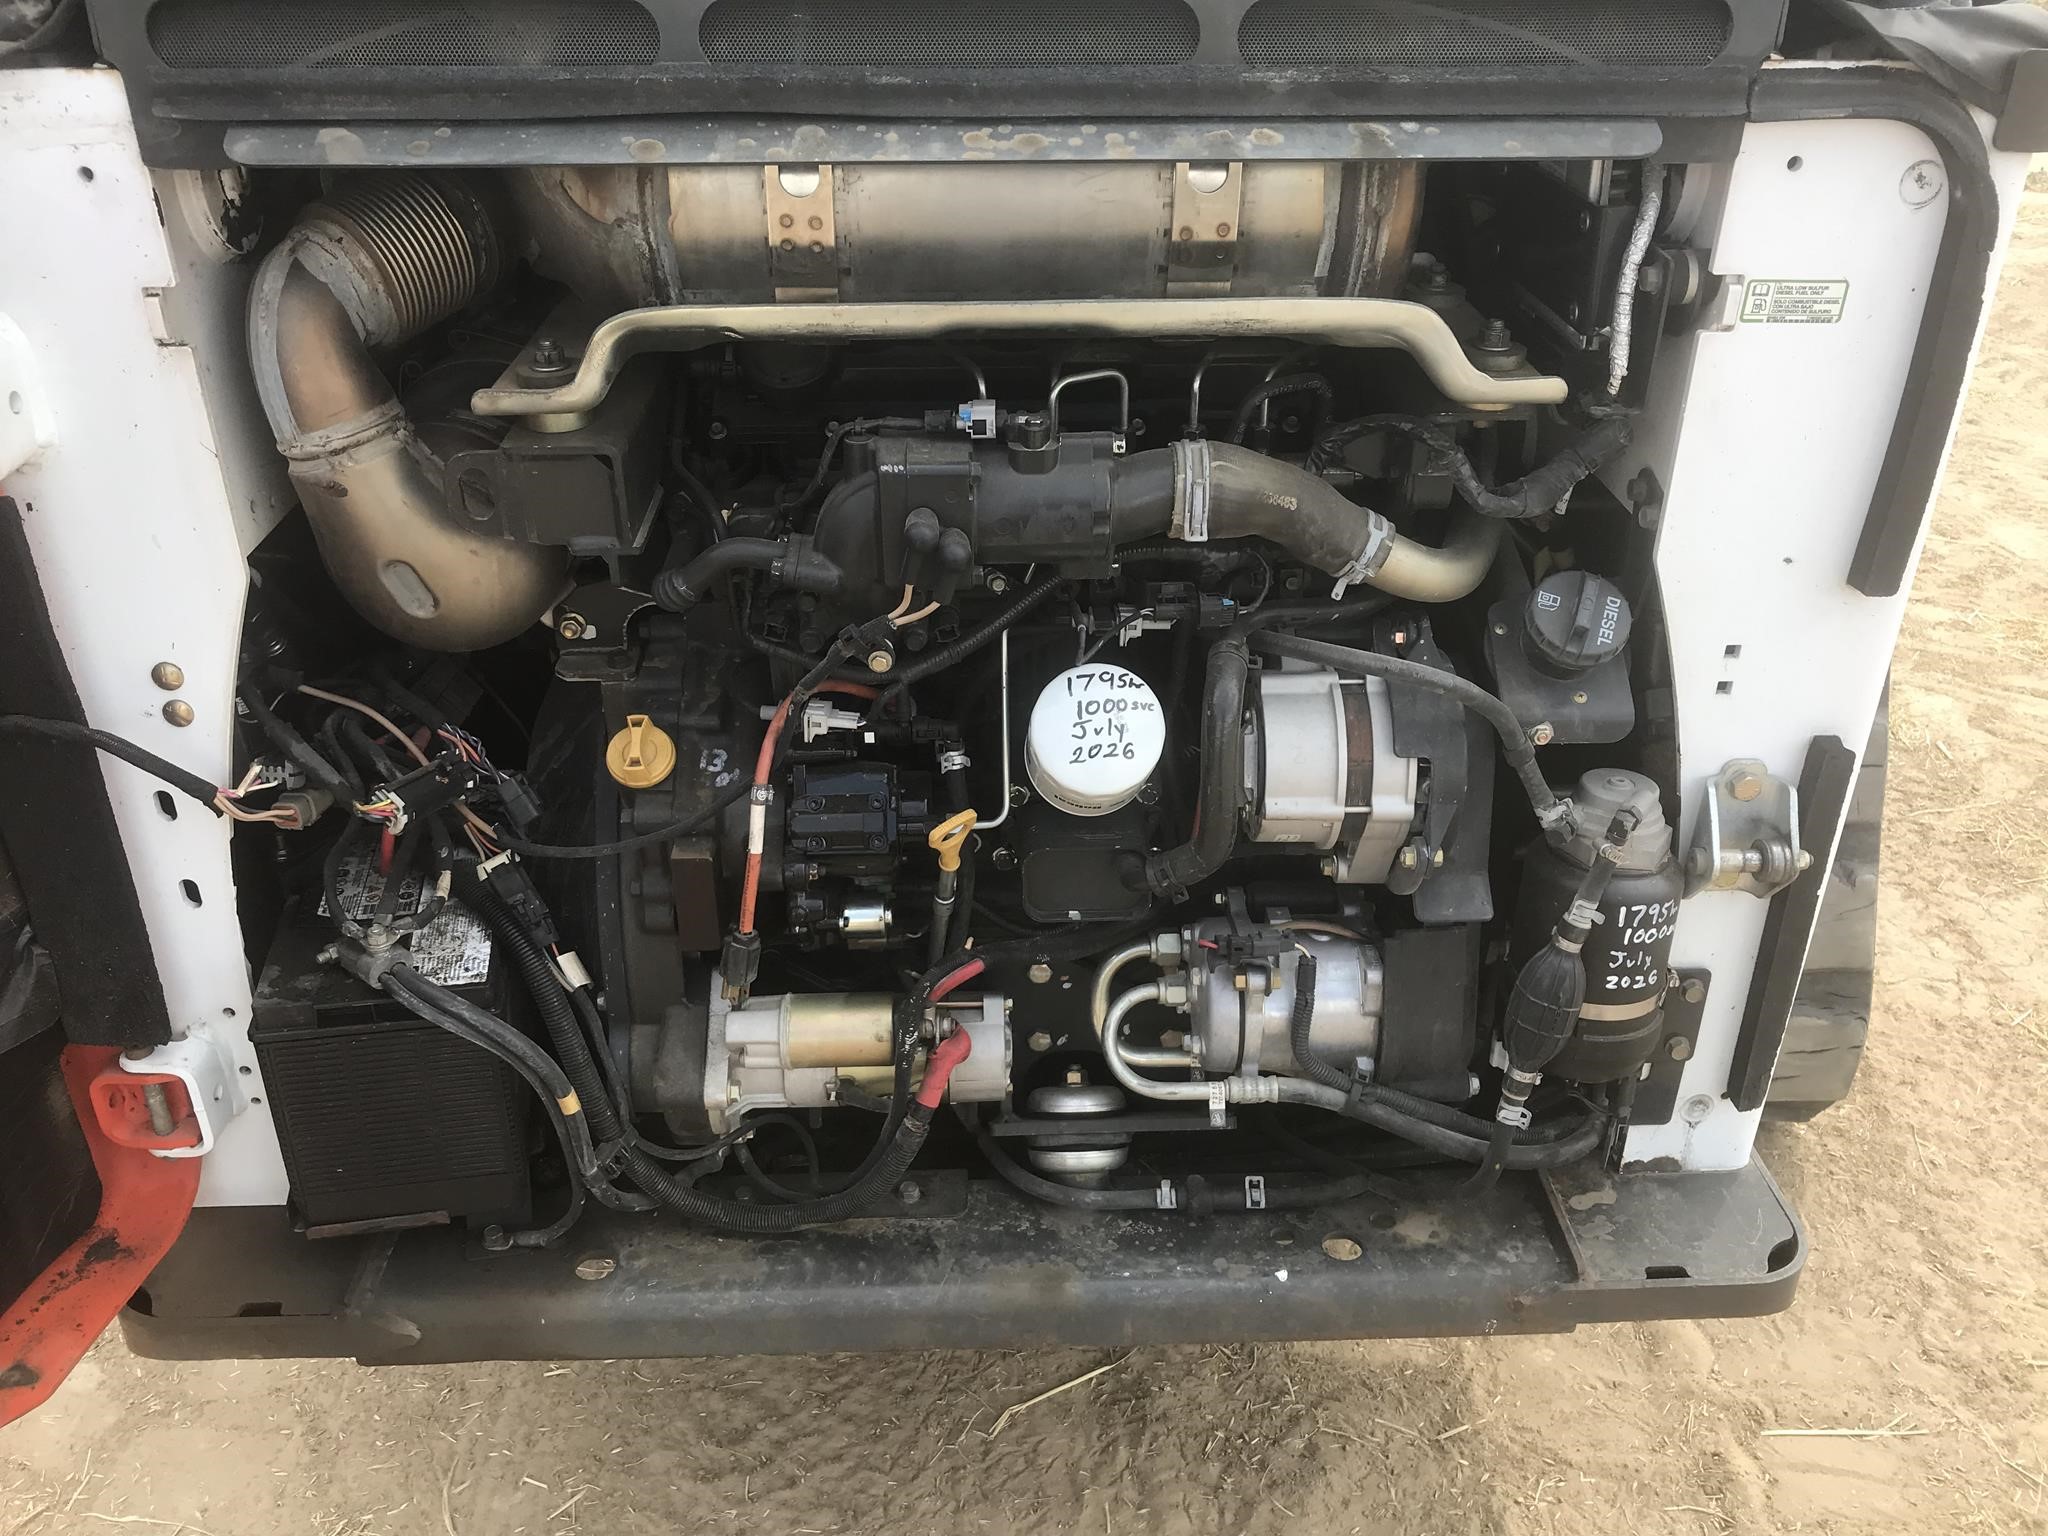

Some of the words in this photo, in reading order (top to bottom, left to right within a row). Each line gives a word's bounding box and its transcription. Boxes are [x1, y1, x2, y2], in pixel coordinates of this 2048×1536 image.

[1597, 595, 1621, 646] DIESEL
[1077, 698, 1128, 721] 1000
[1069, 742, 1135, 764] 2026
[1605, 969, 1658, 990] 2026
